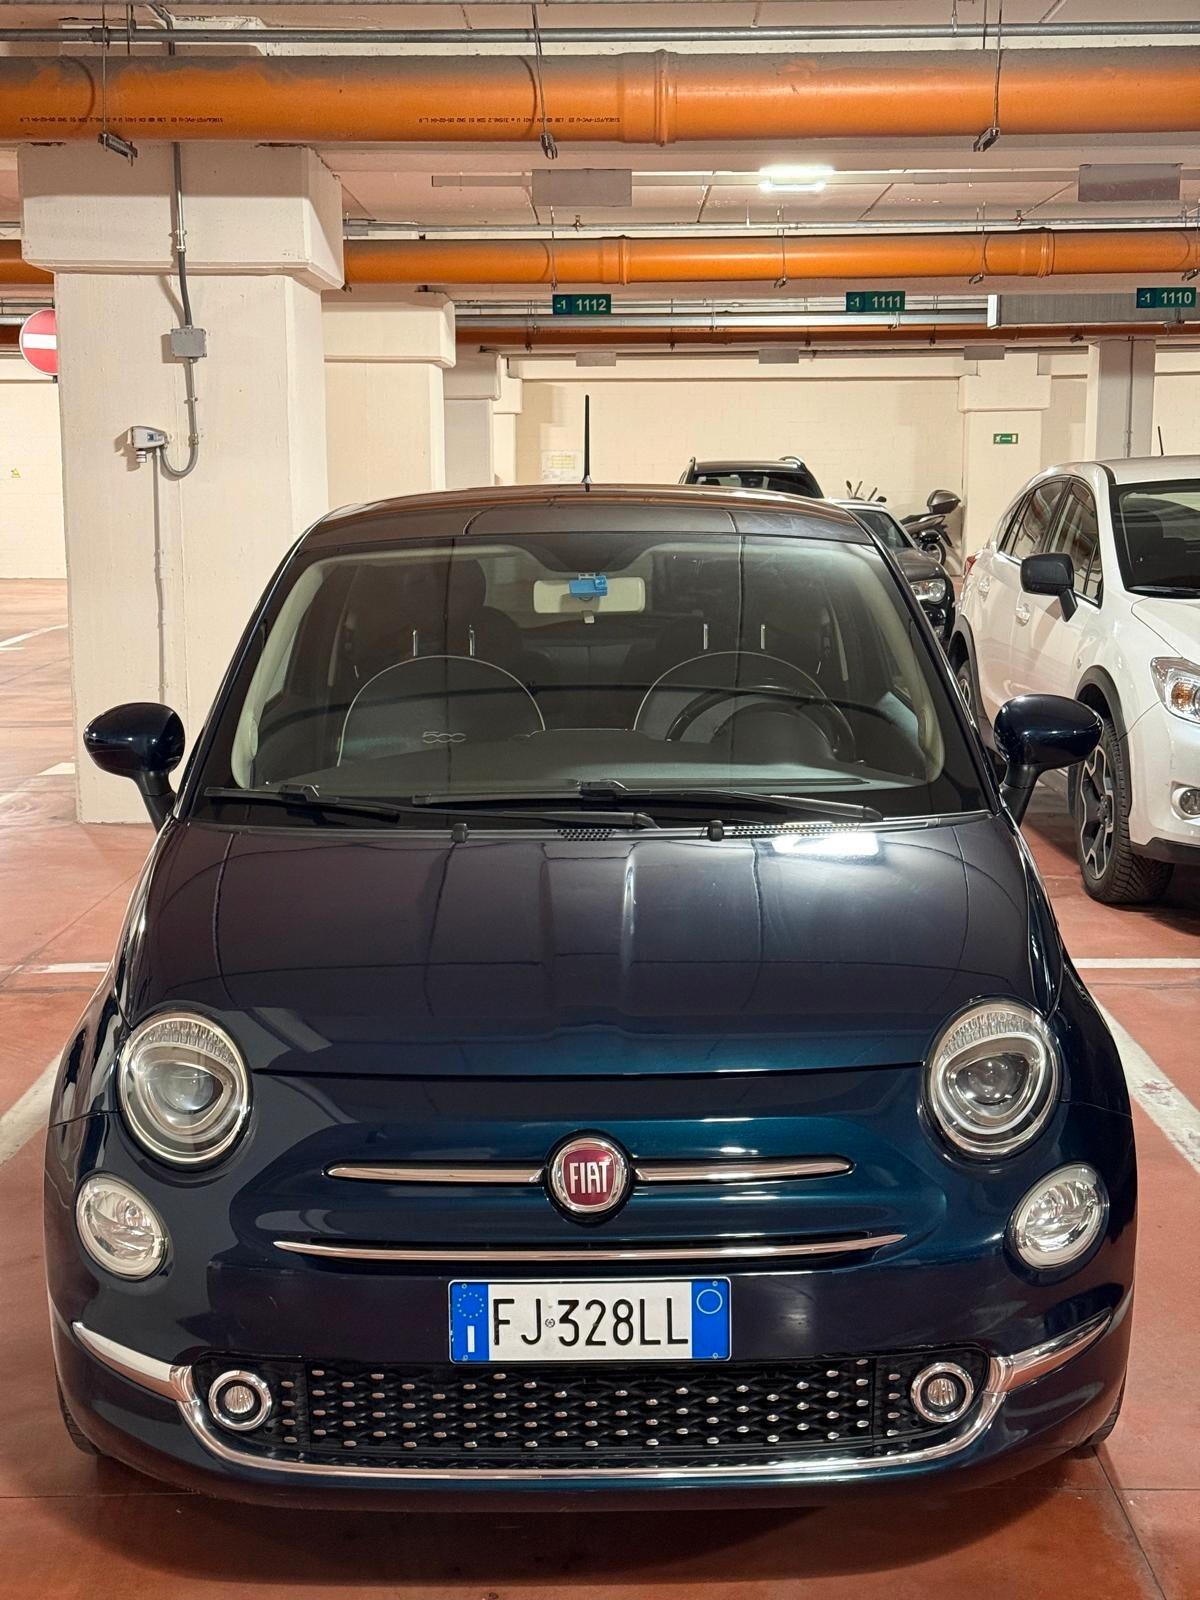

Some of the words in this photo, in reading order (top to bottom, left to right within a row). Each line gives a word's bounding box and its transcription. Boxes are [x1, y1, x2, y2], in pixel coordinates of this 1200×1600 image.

[556, 299, 566, 310] -1
[576, 298, 607, 311] 1112
[850, 296, 860, 308] -1
[872, 295, 900, 309] 1111
[1140, 292, 1151, 303] -1
[1161, 291, 1192, 304] 1110
[421, 730, 467, 744] 500
[569, 1161, 610, 1194] FIAT
[467, 1325, 475, 1352] I
